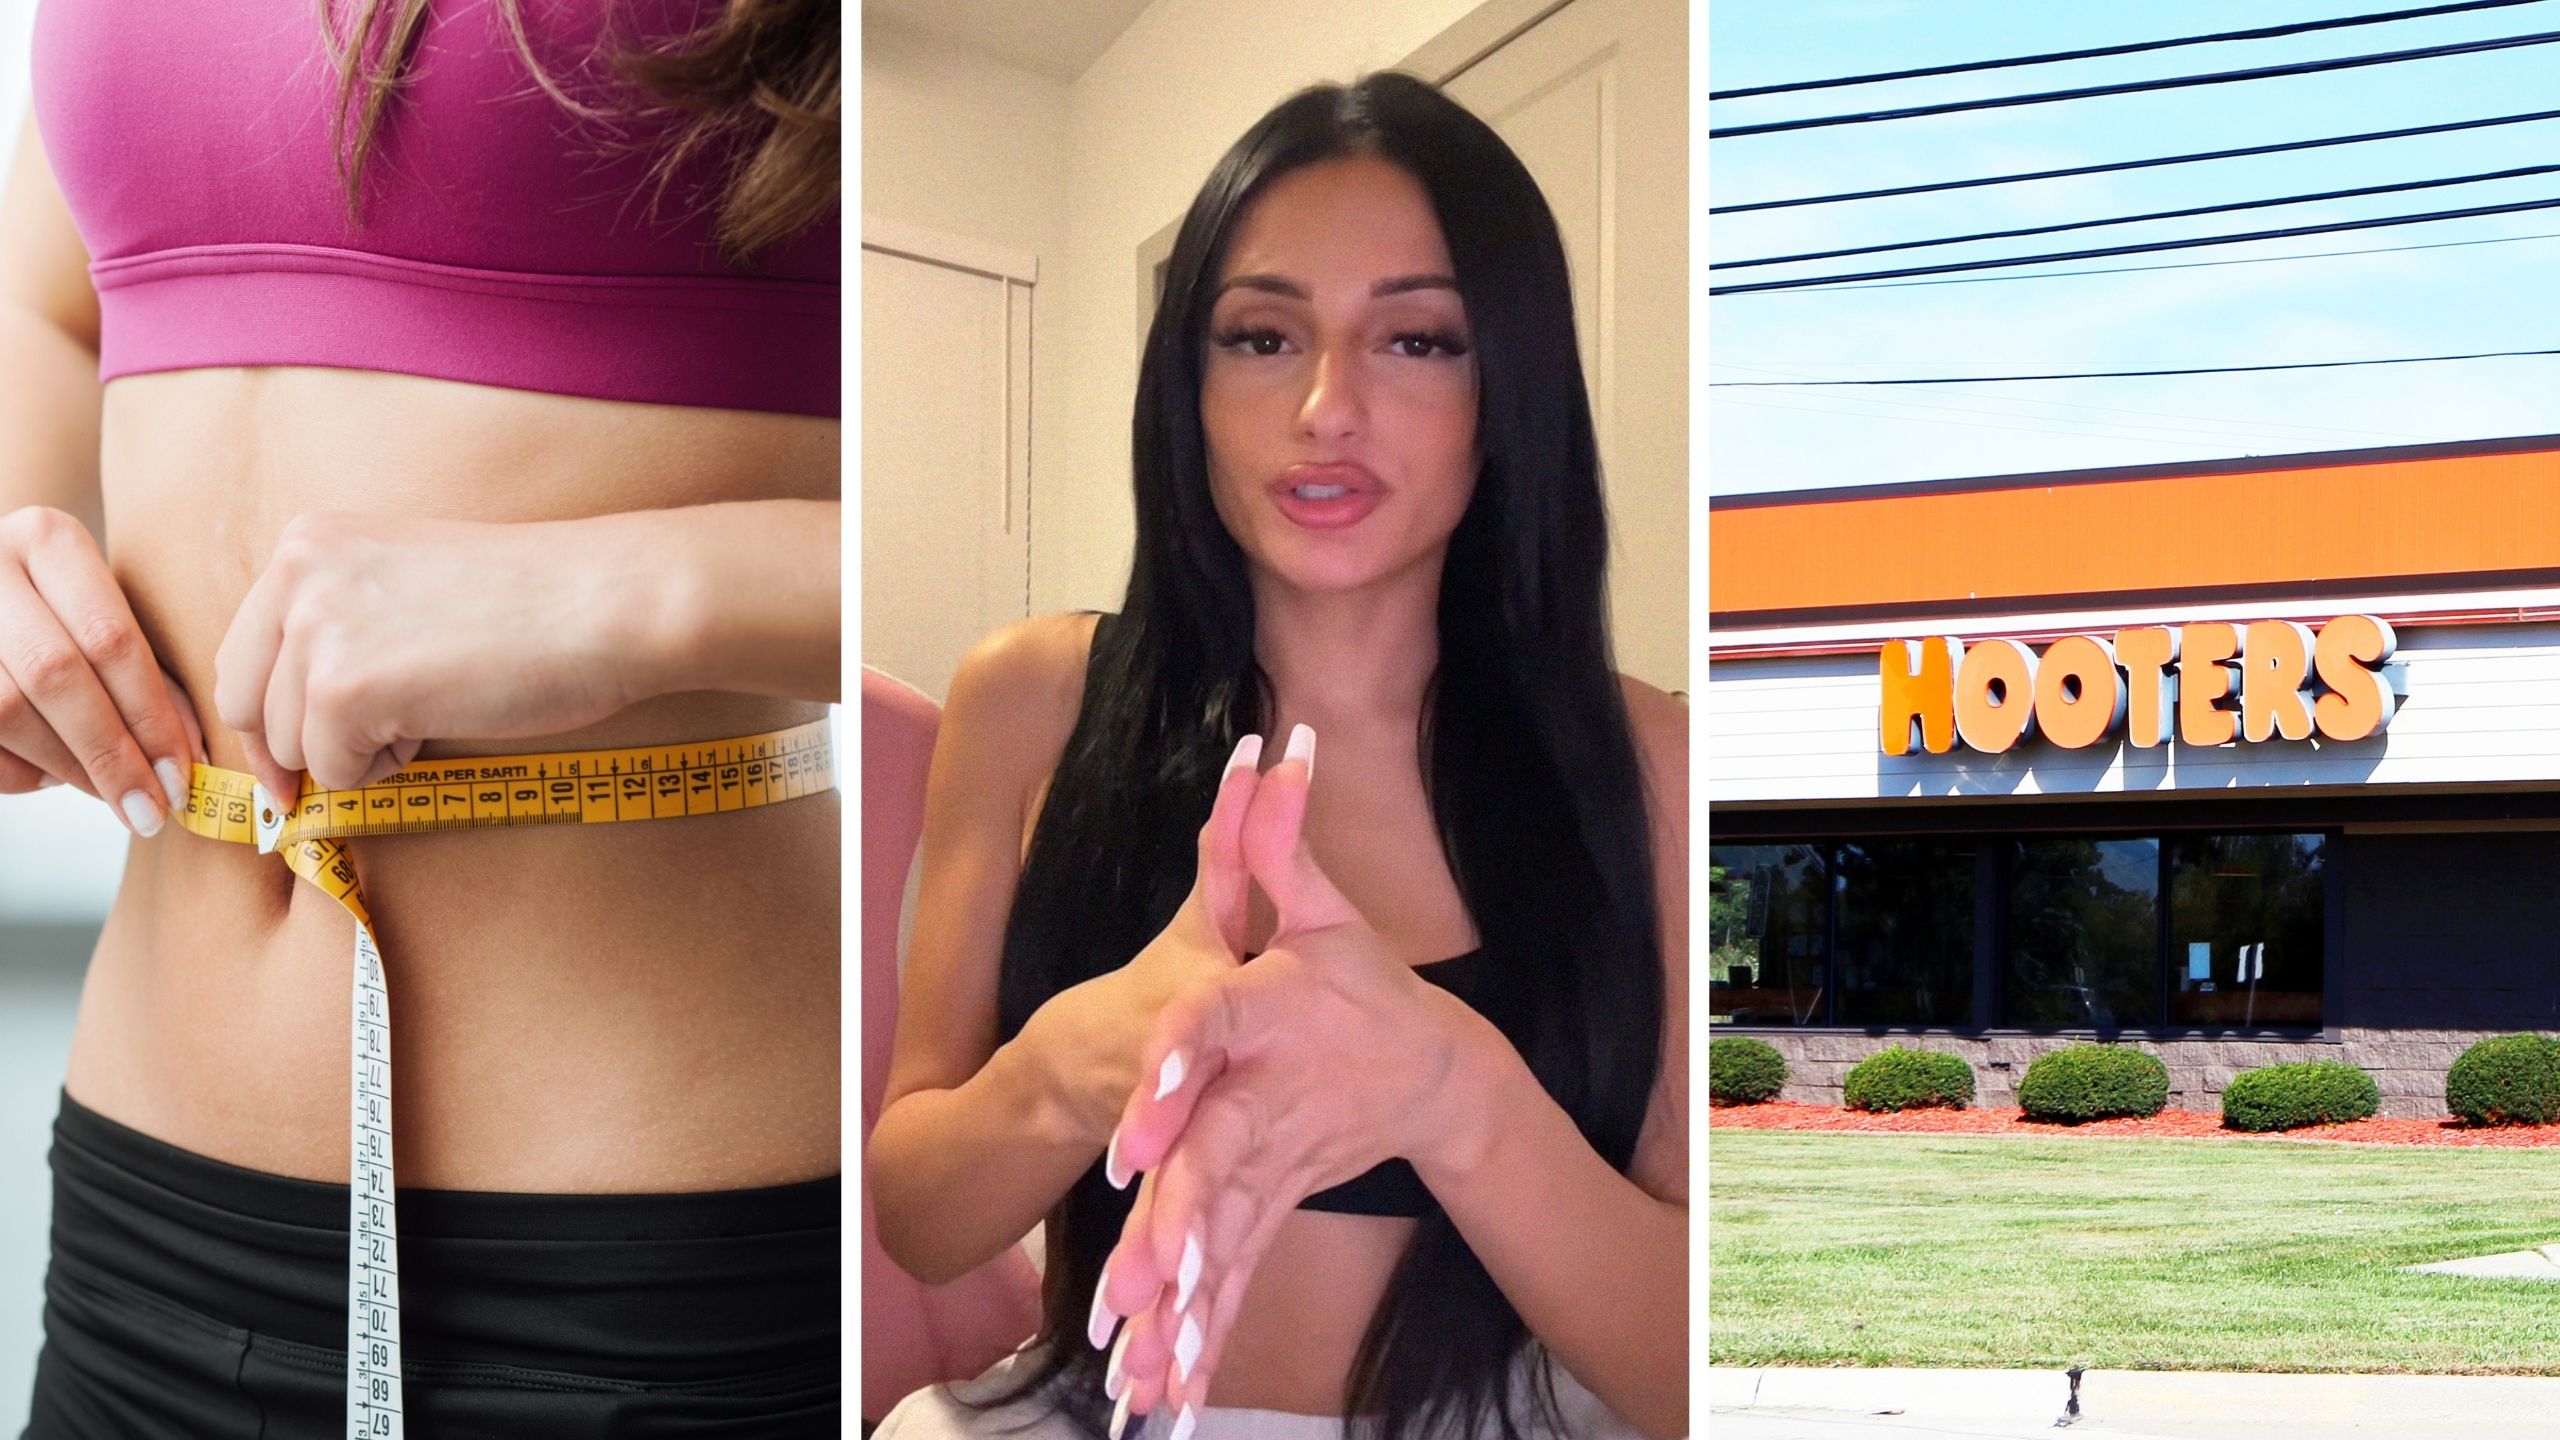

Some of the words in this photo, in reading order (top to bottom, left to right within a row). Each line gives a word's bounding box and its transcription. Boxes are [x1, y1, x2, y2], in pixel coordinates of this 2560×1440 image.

[1879, 614, 2397, 756] HOOTERS
[568, 763, 577, 775] 5
[640, 759, 649, 770] 6
[706, 753, 713, 764] 7
[788, 757, 799, 779] 18
[444, 769, 476, 780] PER
[480, 766, 528, 778] SARTI
[691, 770, 712, 795] 14
[721, 767, 739, 791] 15
[747, 764, 763, 787] 16
[769, 761, 783, 783] 17
[515, 789, 538, 800] 9
[551, 781, 574, 804] 10
[587, 782, 610, 803] 11
[623, 777, 646, 800] 12
[658, 774, 680, 797] 13
[203, 795, 219, 818] 62
[305, 803, 324, 815] 3
[337, 799, 358, 811] 4
[372, 797, 395, 809] 5
[407, 795, 430, 807] 6
[443, 794, 466, 805] 7
[479, 792, 502, 803] 8
[227, 801, 247, 824] 63
[331, 860, 355, 884] 68
[370, 993, 380, 1018] 79
[370, 1029, 381, 1053] 78
[370, 1065, 382, 1088] 77
[370, 1099, 382, 1124] 76
[370, 1134, 383, 1158] 75
[371, 1169, 384, 1193] 74
[372, 1204, 386, 1228] 73
[372, 1239, 387, 1263] 72
[374, 1274, 387, 1298] 71
[372, 1309, 387, 1333] 70
[372, 1343, 388, 1367] 69
[372, 1378, 389, 1402] 68
[373, 1413, 390, 1436] 67
